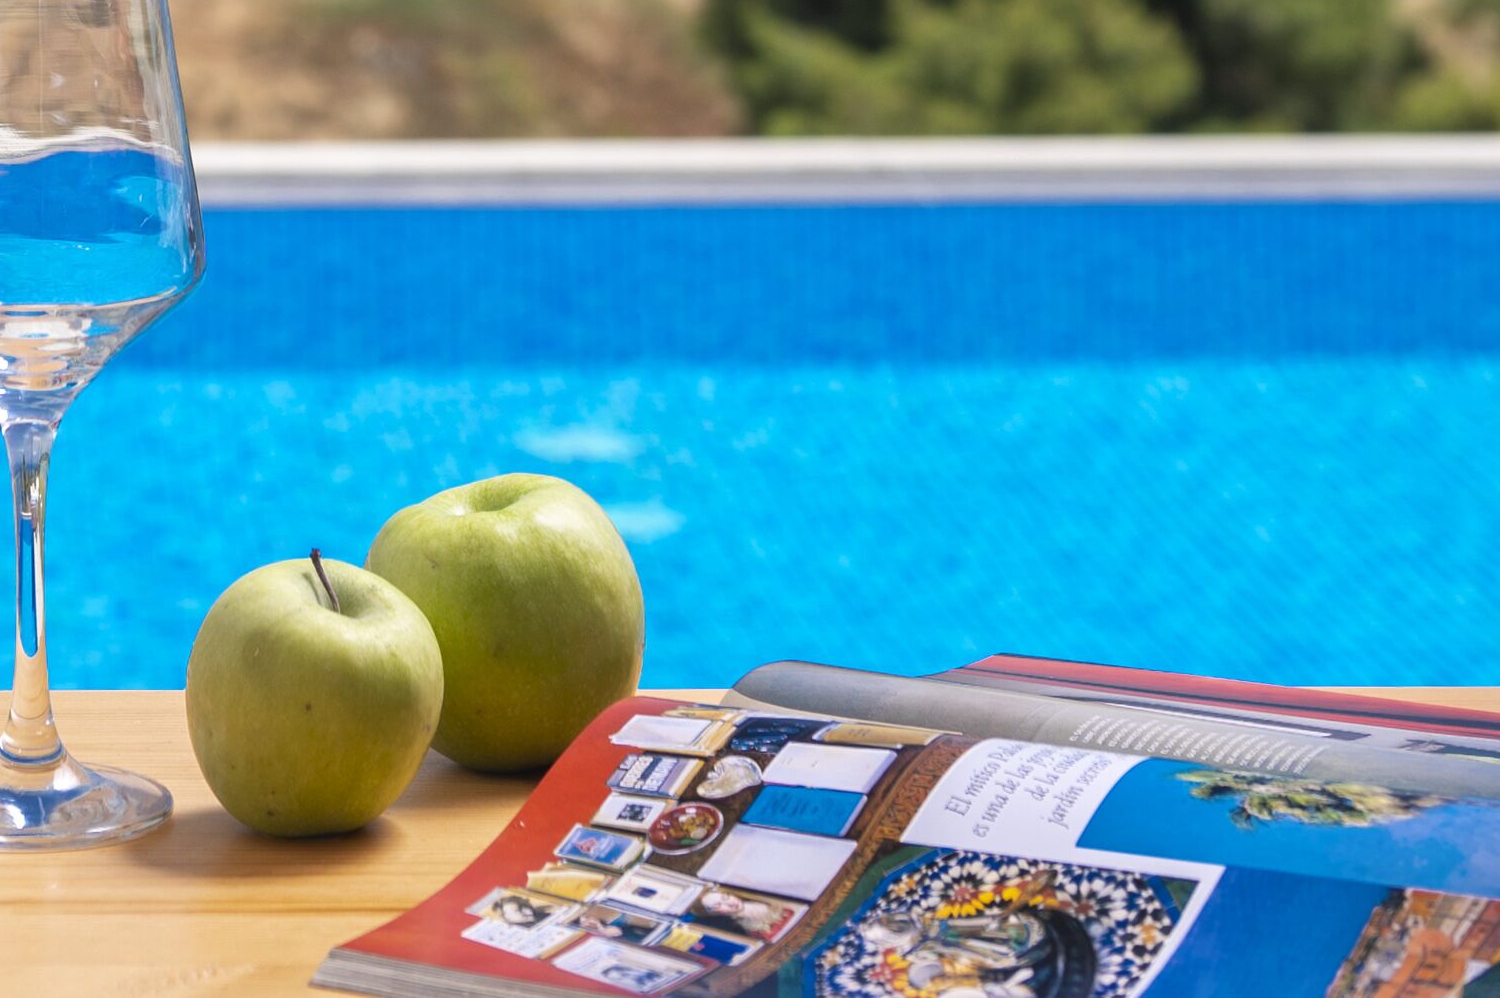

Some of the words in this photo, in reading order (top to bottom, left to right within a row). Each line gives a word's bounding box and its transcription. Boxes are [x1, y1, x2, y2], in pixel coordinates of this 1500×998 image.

[1004, 763, 1034, 780] las
[1033, 773, 1059, 786] la
[995, 781, 1021, 795] de
[1024, 784, 1050, 801] de
[945, 795, 972, 817] El
[981, 793, 1009, 823] una
[972, 824, 990, 838] es
